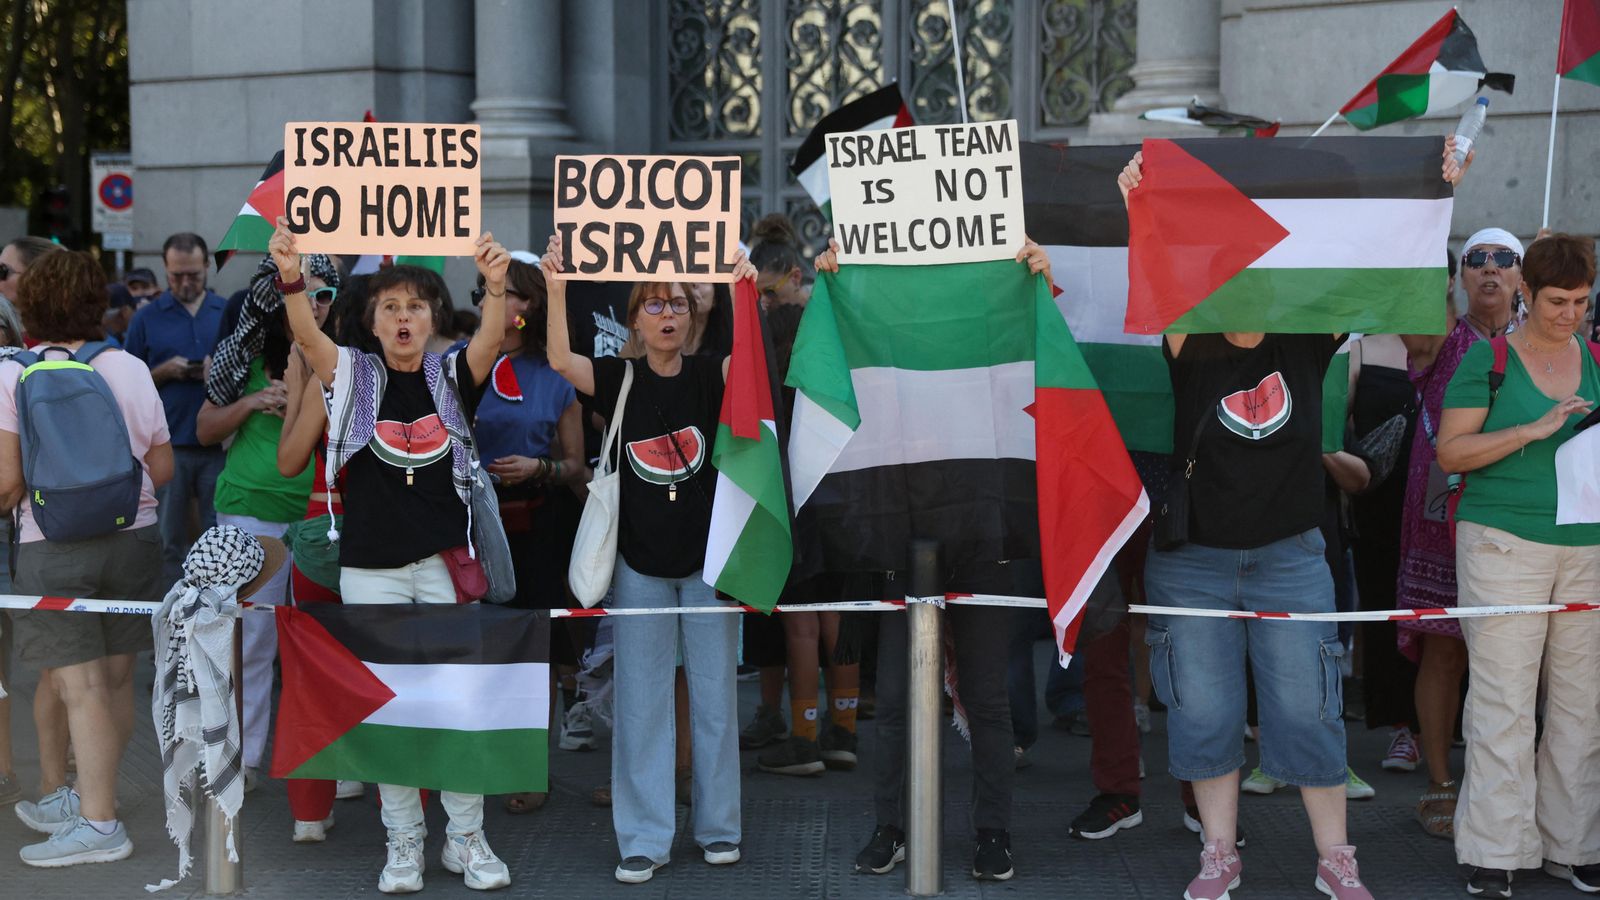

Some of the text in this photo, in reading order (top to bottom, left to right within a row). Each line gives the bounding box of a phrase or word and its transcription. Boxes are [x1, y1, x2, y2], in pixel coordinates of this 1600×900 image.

[294, 127, 479, 169] ISRAELIES
[829, 123, 1012, 168] ISRAEL TEAM
[557, 158, 740, 212] BOICOT
[861, 165, 1013, 205] IS NOT
[286, 185, 470, 238] GO HOME
[839, 213, 1007, 255] WELCOME
[557, 221, 737, 274] ISRAEL
